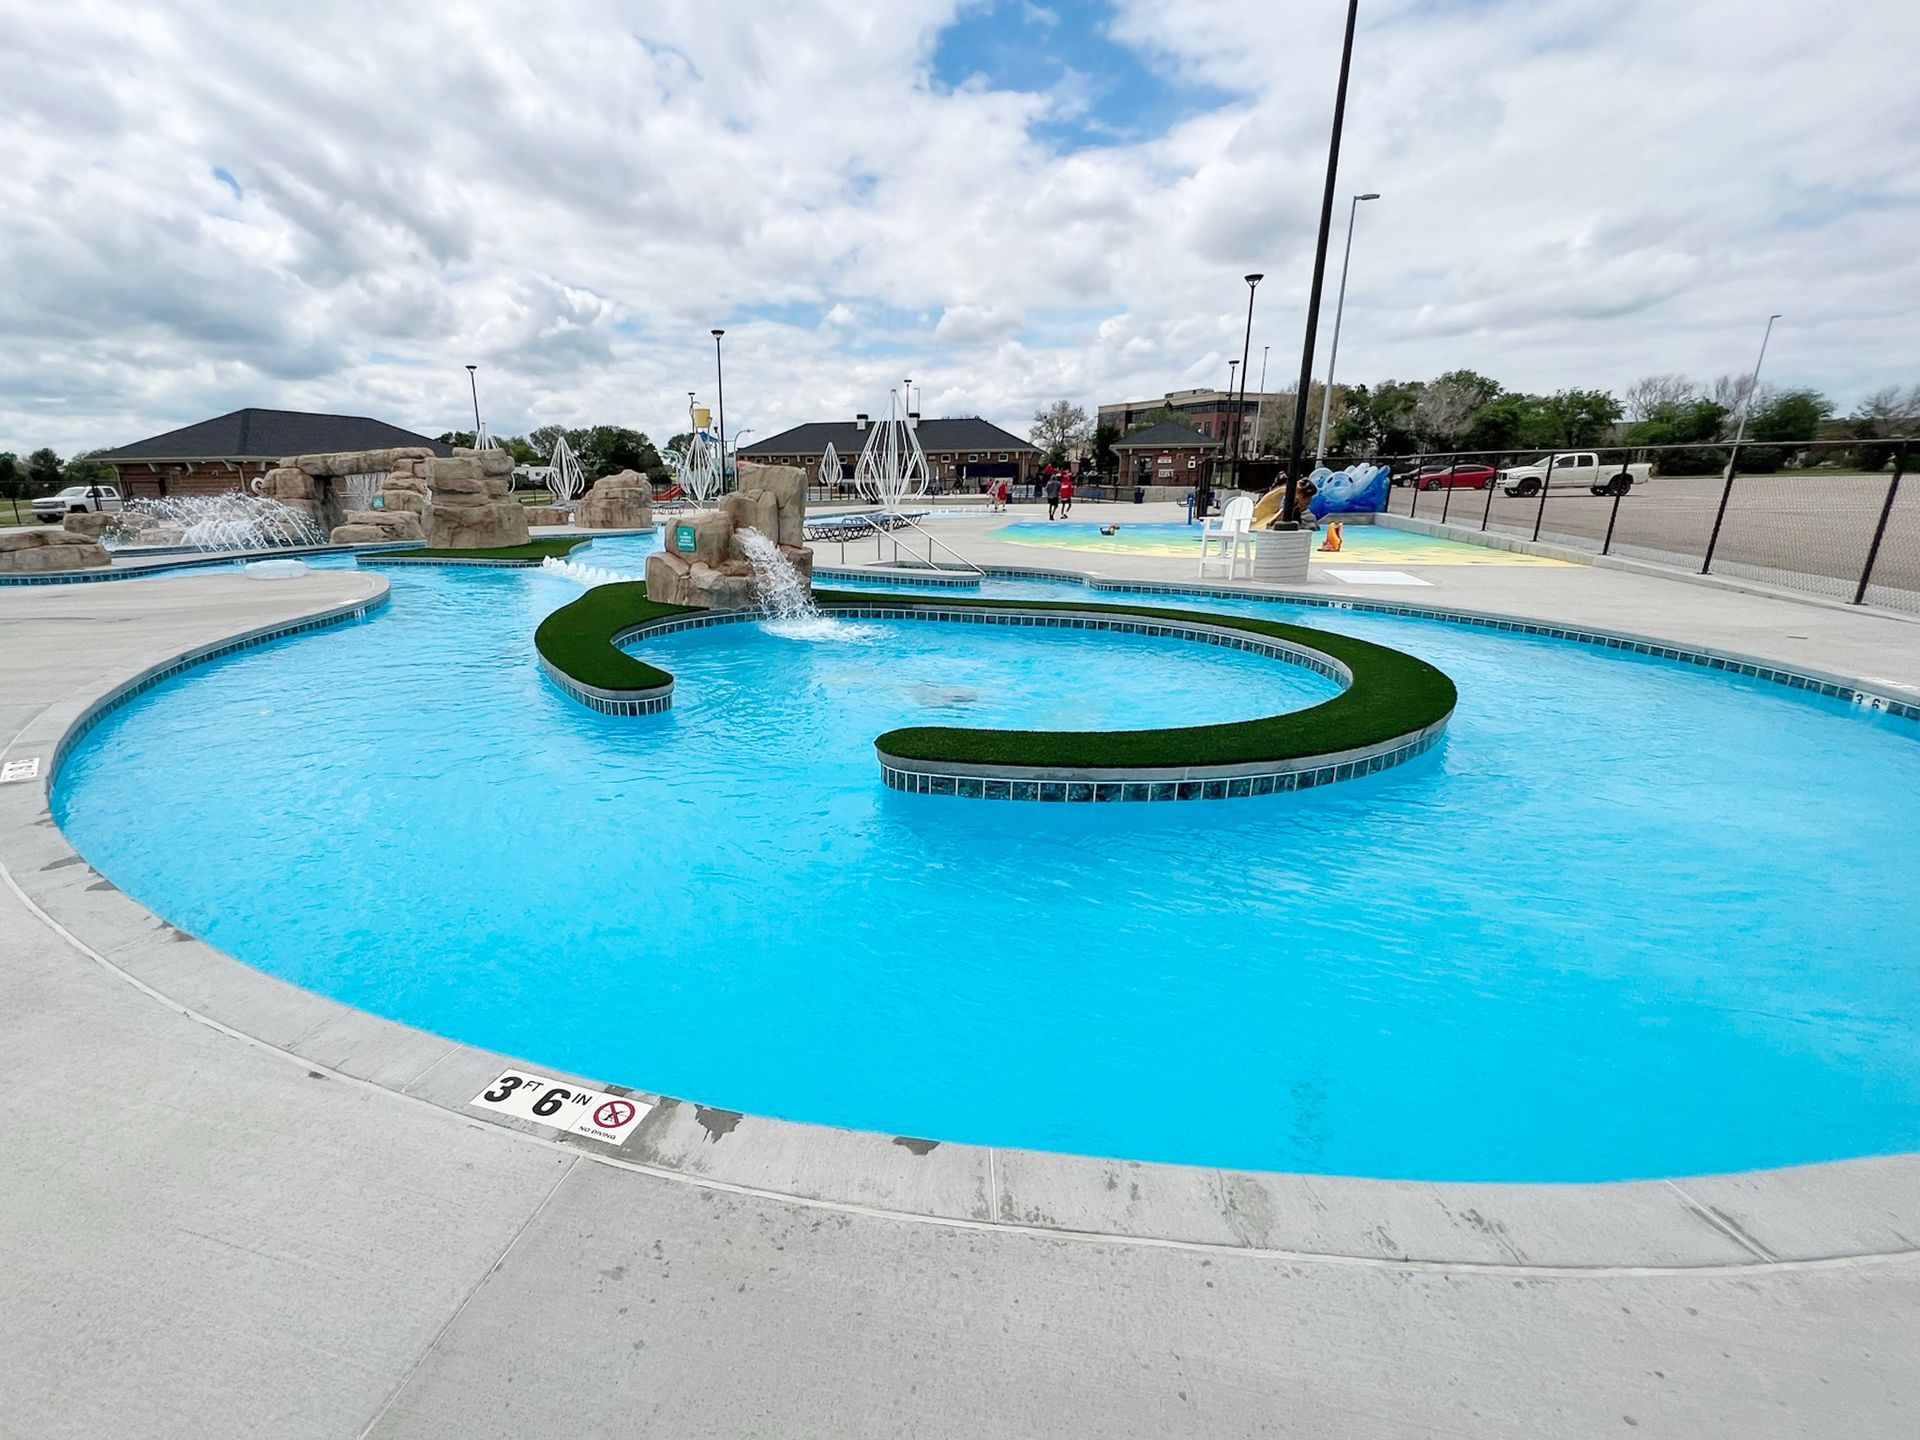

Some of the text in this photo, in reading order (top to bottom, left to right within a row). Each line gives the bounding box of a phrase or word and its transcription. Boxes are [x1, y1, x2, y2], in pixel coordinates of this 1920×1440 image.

[1856, 693, 1864, 704] 3
[1872, 698, 1880, 709] 6
[484, 1076, 593, 1116] 3 FT 6 IN
[578, 1125, 616, 1140] NO DIVING
